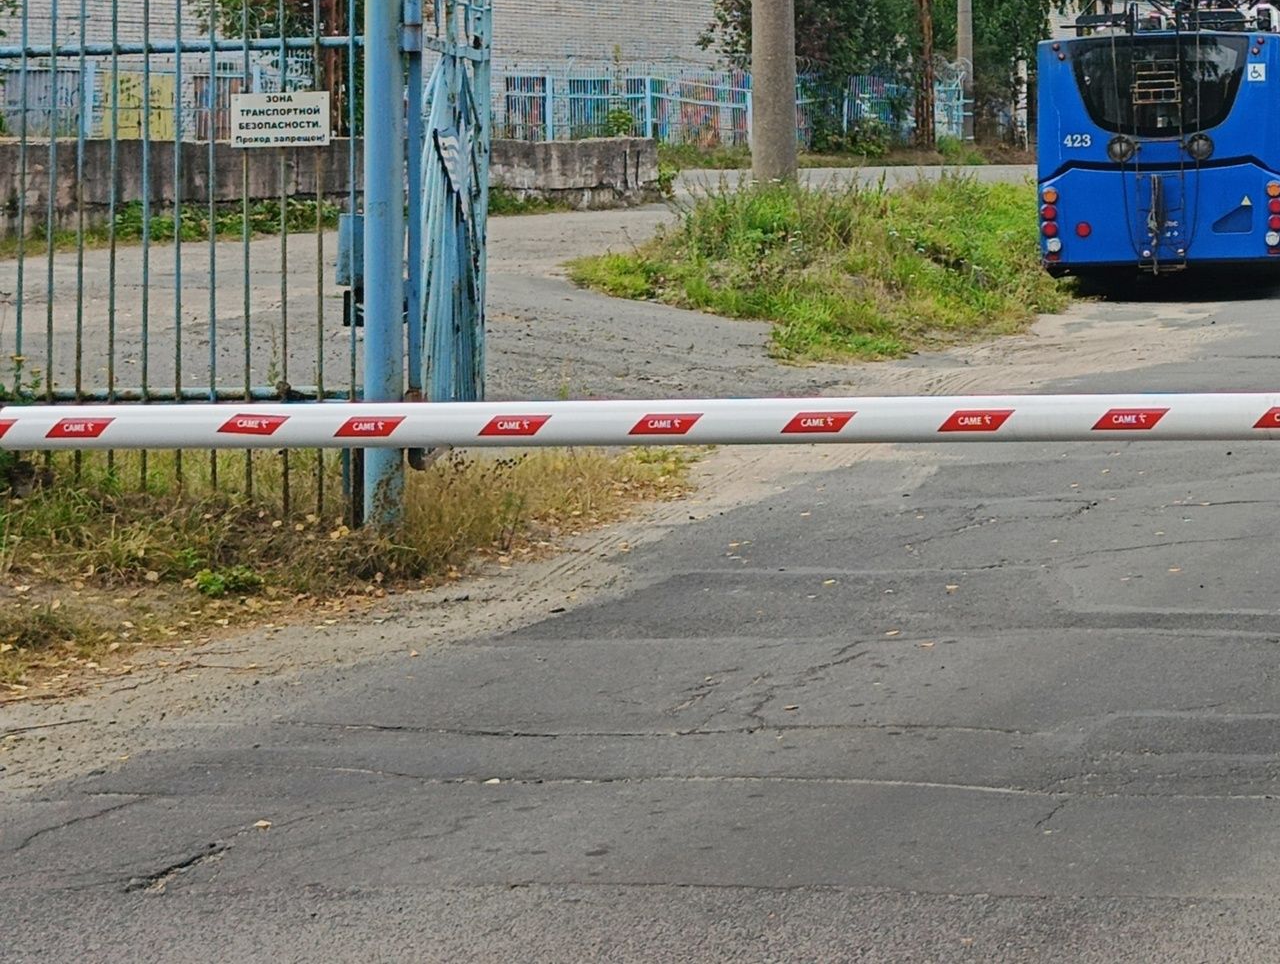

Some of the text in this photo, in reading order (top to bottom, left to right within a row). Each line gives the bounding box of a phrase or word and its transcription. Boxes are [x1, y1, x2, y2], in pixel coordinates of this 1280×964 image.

[266, 95, 293, 103] ЗОНА
[240, 105, 320, 117] ТРАНСПОРТНОЙ
[238, 121, 322, 130] БЕЗОПАСНОСТИ.
[236, 134, 325, 144] Проход запрещен!
[1063, 134, 1092, 147] 423
[237, 418, 259, 428] CAME
[648, 419, 672, 429] CAME
[801, 417, 825, 427] CAME
[958, 415, 982, 425] CAME
[1112, 414, 1136, 424] CAME
[63, 423, 85, 432] CAME
[352, 422, 375, 431] CAME
[497, 420, 520, 430] CAME
